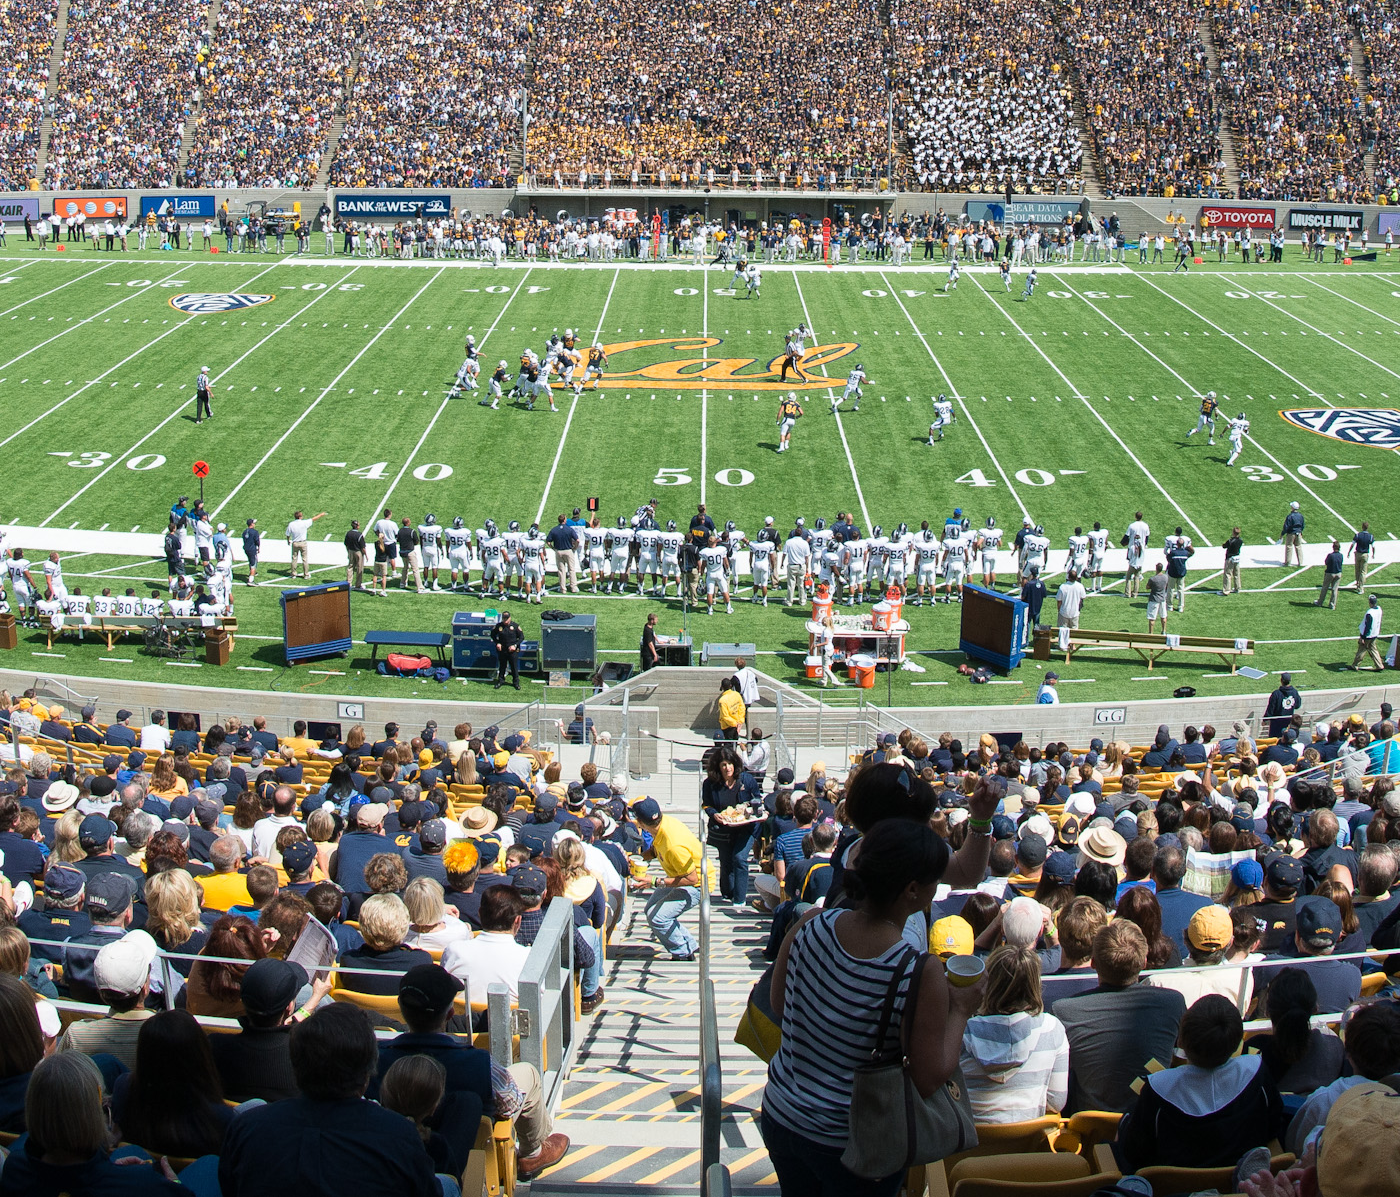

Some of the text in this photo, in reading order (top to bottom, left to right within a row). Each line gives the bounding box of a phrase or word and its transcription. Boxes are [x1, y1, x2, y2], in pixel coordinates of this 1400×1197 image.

[174, 198, 200, 209] Lam
[338, 201, 374, 212] BANK
[1012, 204, 1062, 212] BEAR DATA
[1224, 212, 1273, 224] TOYOTA
[1291, 213, 1360, 228] MUSCLE MILK
[551, 337, 861, 391] Cal
[785, 404, 797, 414] 84
[941, 407, 950, 415] 28
[67, 451, 166, 470] 30
[349, 462, 453, 481] 40
[653, 468, 755, 486] 50
[954, 468, 1055, 486] 40
[1240, 464, 1338, 482] 30
[450, 536, 464, 546] 95
[591, 536, 603, 546] 91
[614, 536, 628, 546] 97
[664, 539, 678, 549] 99
[816, 537, 823, 547] 9
[985, 537, 998, 547] 60
[486, 546, 499, 556] 38
[854, 547, 863, 558] 11
[890, 550, 903, 560] 52
[950, 545, 964, 556] 40
[708, 554, 722, 565] 90
[10, 567, 21, 577] 74
[70, 601, 85, 612] 25
[96, 601, 107, 612] 83
[118, 603, 131, 614] 80
[345, 704, 357, 717] G
[1097, 710, 1122, 722] GG
[395, 834, 412, 847] Cal
